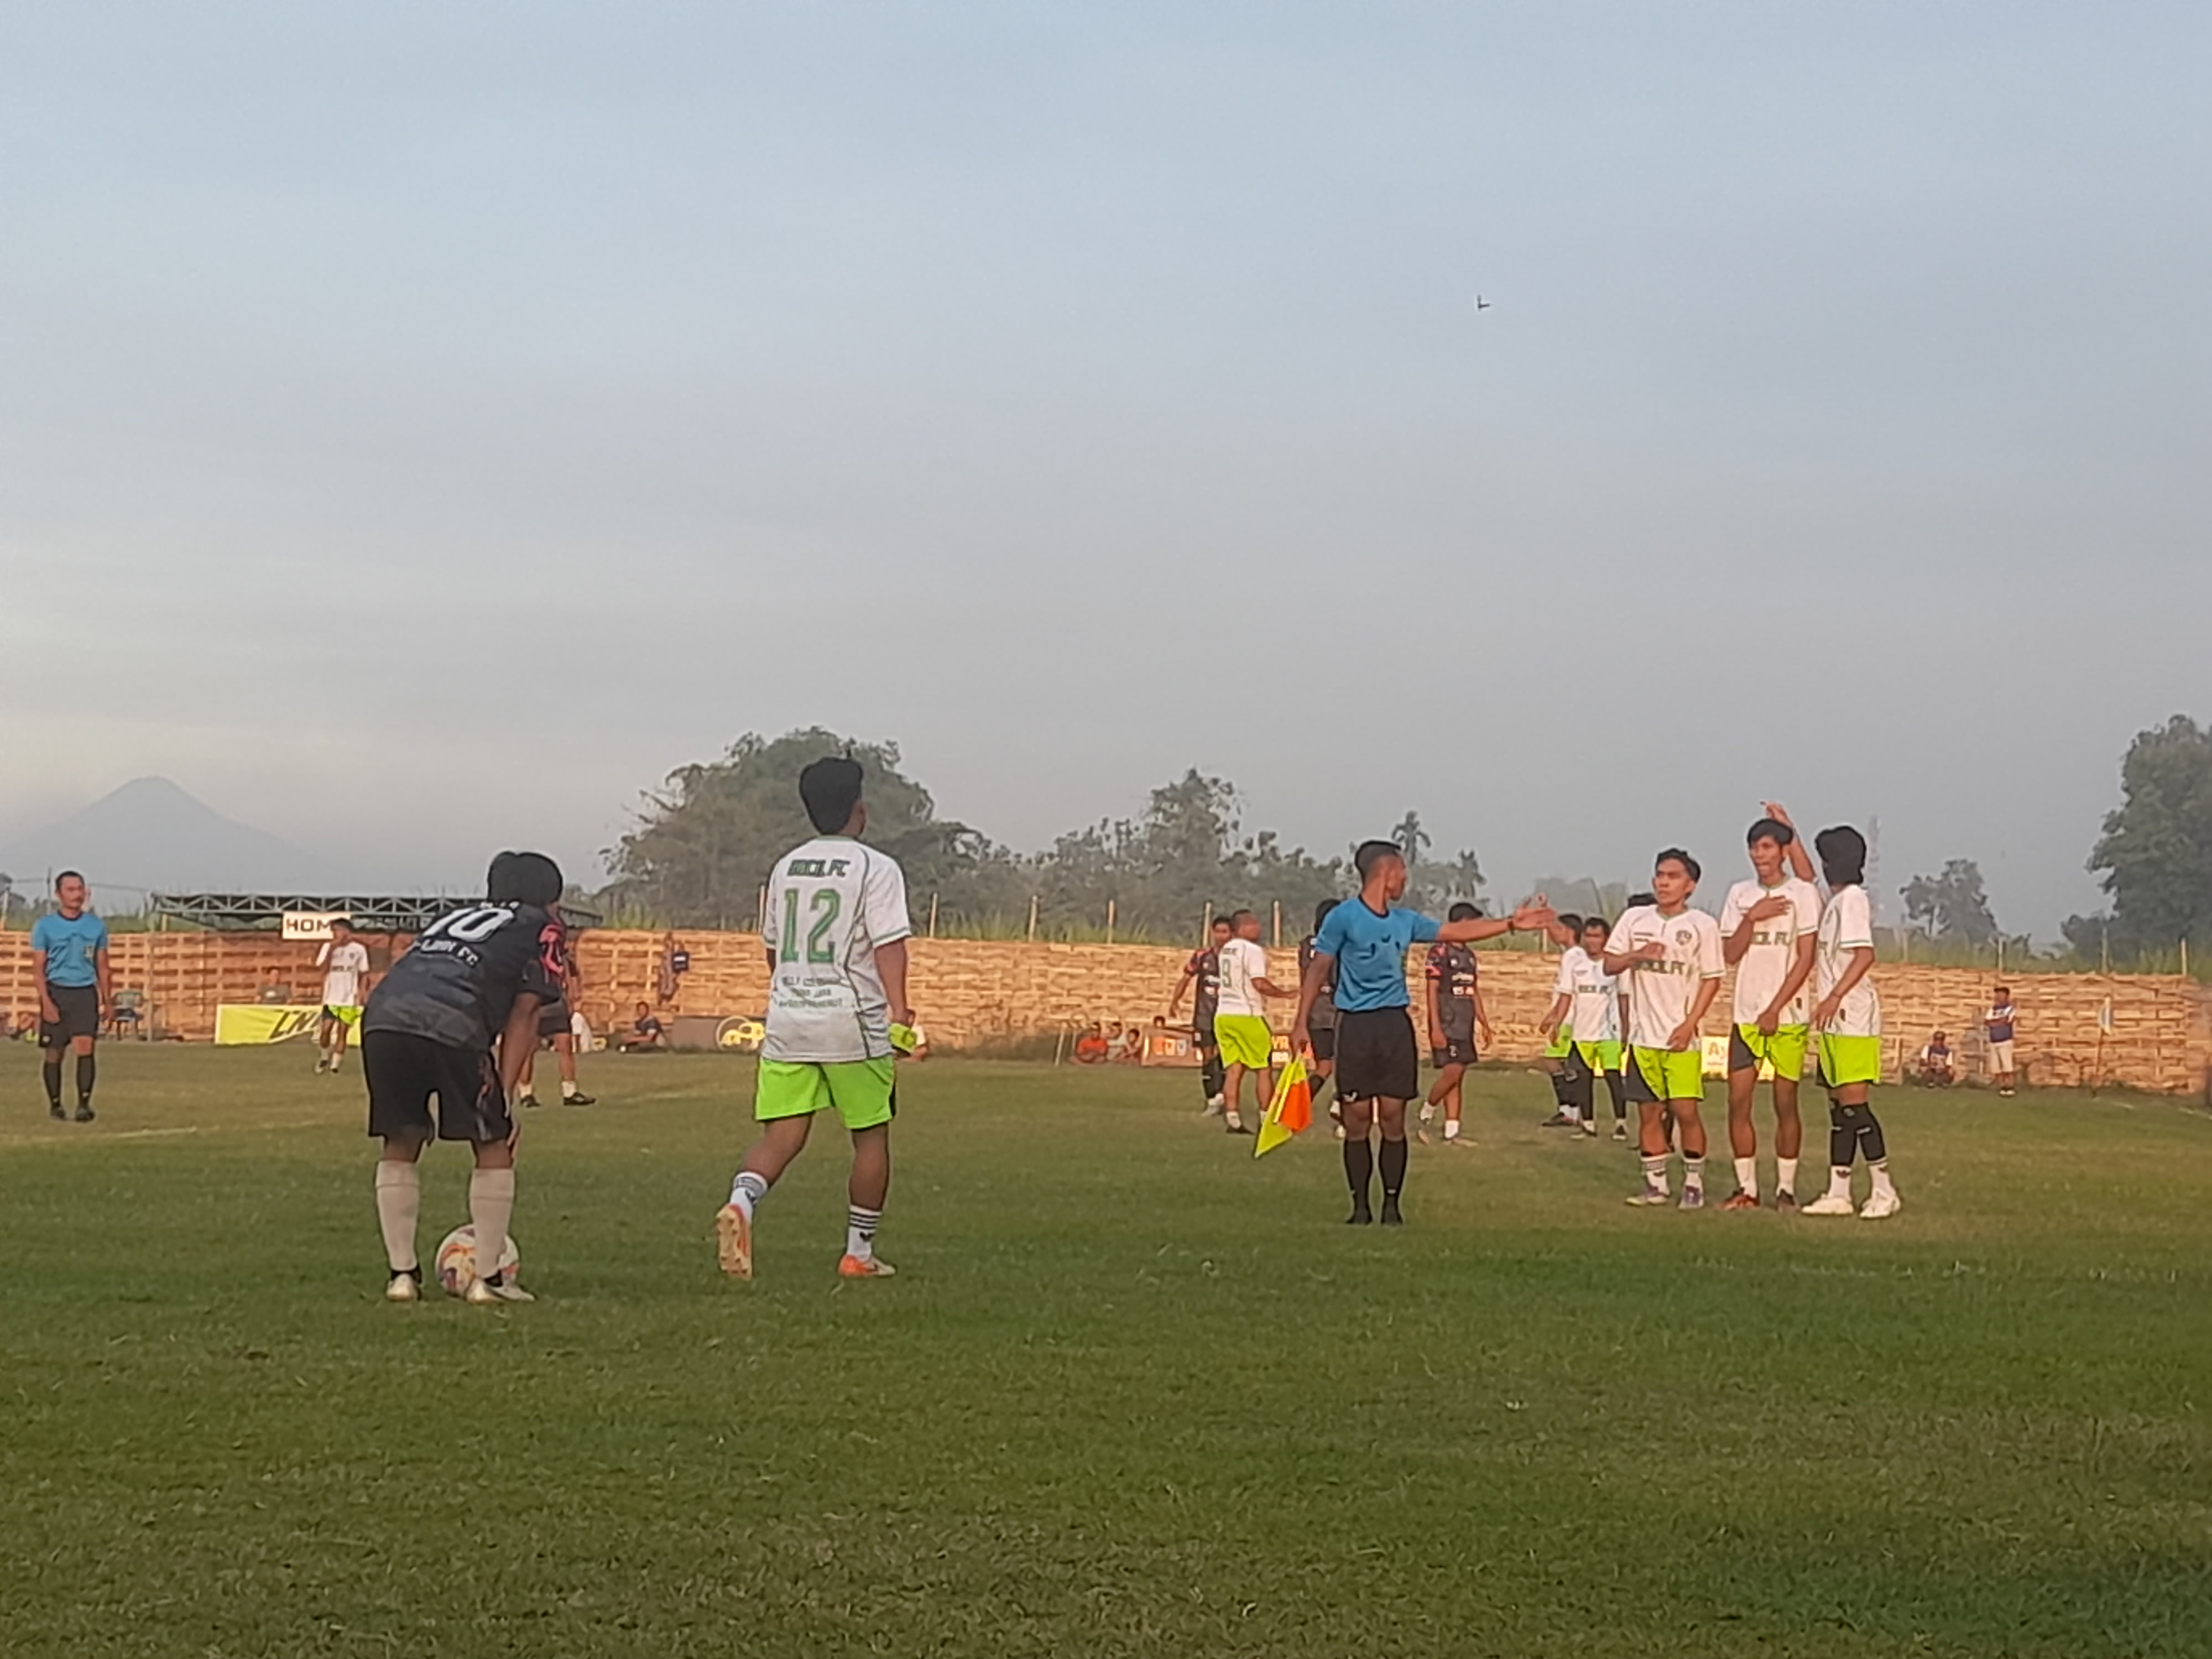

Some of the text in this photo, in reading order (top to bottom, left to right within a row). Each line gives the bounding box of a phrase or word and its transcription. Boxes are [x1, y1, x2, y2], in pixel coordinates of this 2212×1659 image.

[286, 919, 333, 932] HOM
[422, 907, 515, 942] 10
[781, 888, 841, 963] 12
